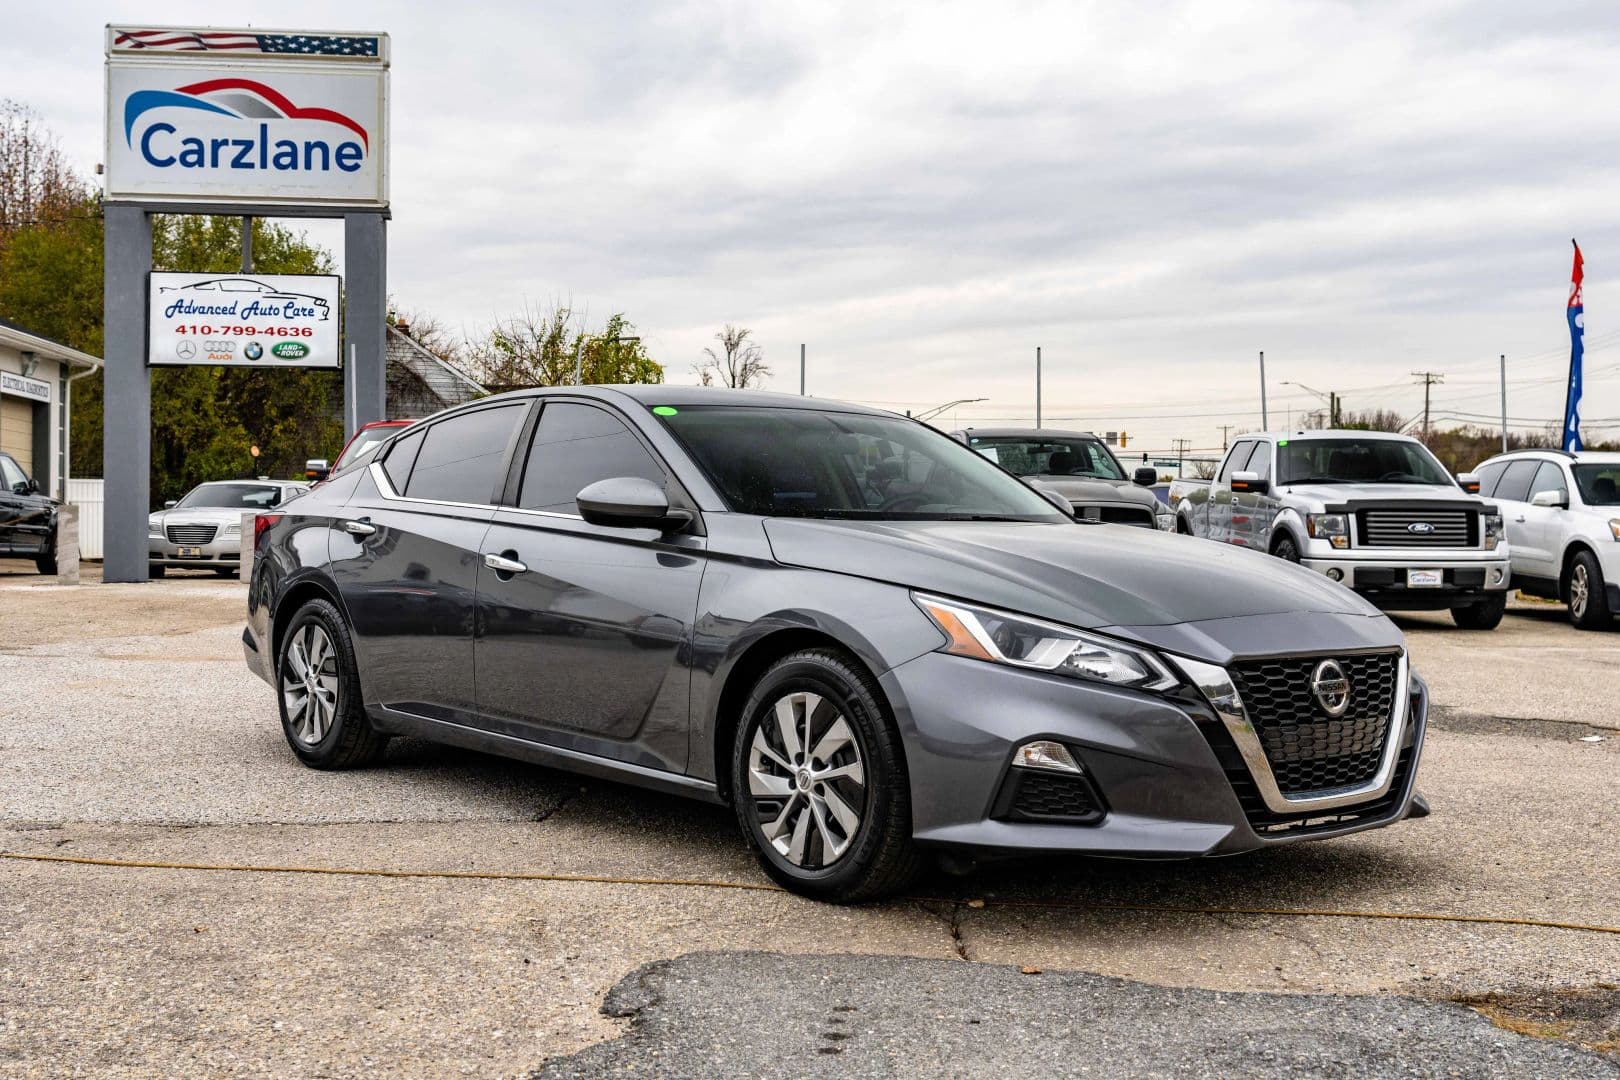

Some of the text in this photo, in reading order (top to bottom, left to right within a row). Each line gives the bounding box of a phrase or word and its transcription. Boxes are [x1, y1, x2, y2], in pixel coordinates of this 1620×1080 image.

[141, 122, 363, 172] Carzlane
[165, 298, 315, 320] Advanced Auto Care
[175, 325, 313, 337] 410-799-4636
[207, 352, 233, 361] Audi
[1317, 682, 1347, 692] NISSAN
